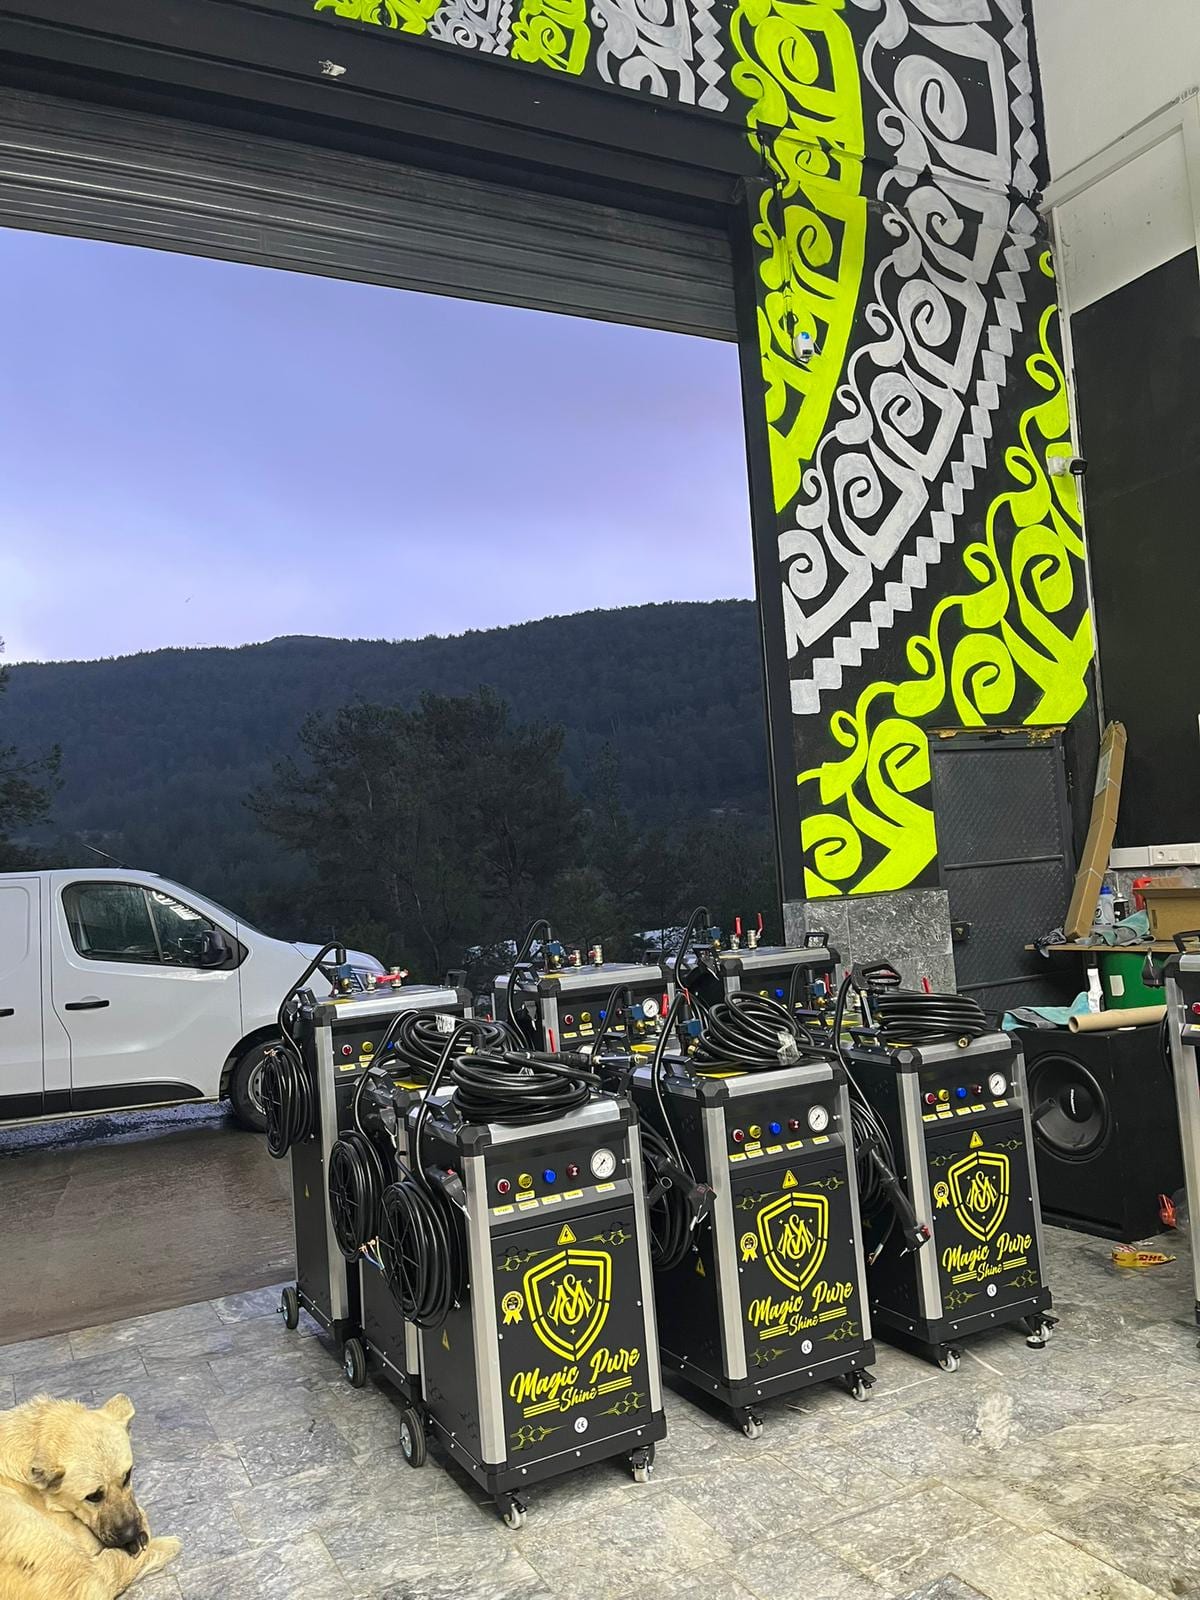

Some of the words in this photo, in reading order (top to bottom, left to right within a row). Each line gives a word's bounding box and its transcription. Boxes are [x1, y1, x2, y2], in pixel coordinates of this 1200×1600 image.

[942, 1245, 990, 1272] Magic
[997, 1232, 1033, 1260] Pure
[1138, 1254, 1165, 1262] DHL
[976, 1262, 1003, 1282] Shine
[748, 1296, 804, 1328] Magic
[812, 1281, 853, 1312] Pure
[788, 1314, 819, 1337] Shine
[510, 1366, 580, 1404] Magic
[589, 1348, 640, 1384] Pure
[559, 1387, 598, 1412] Shine
